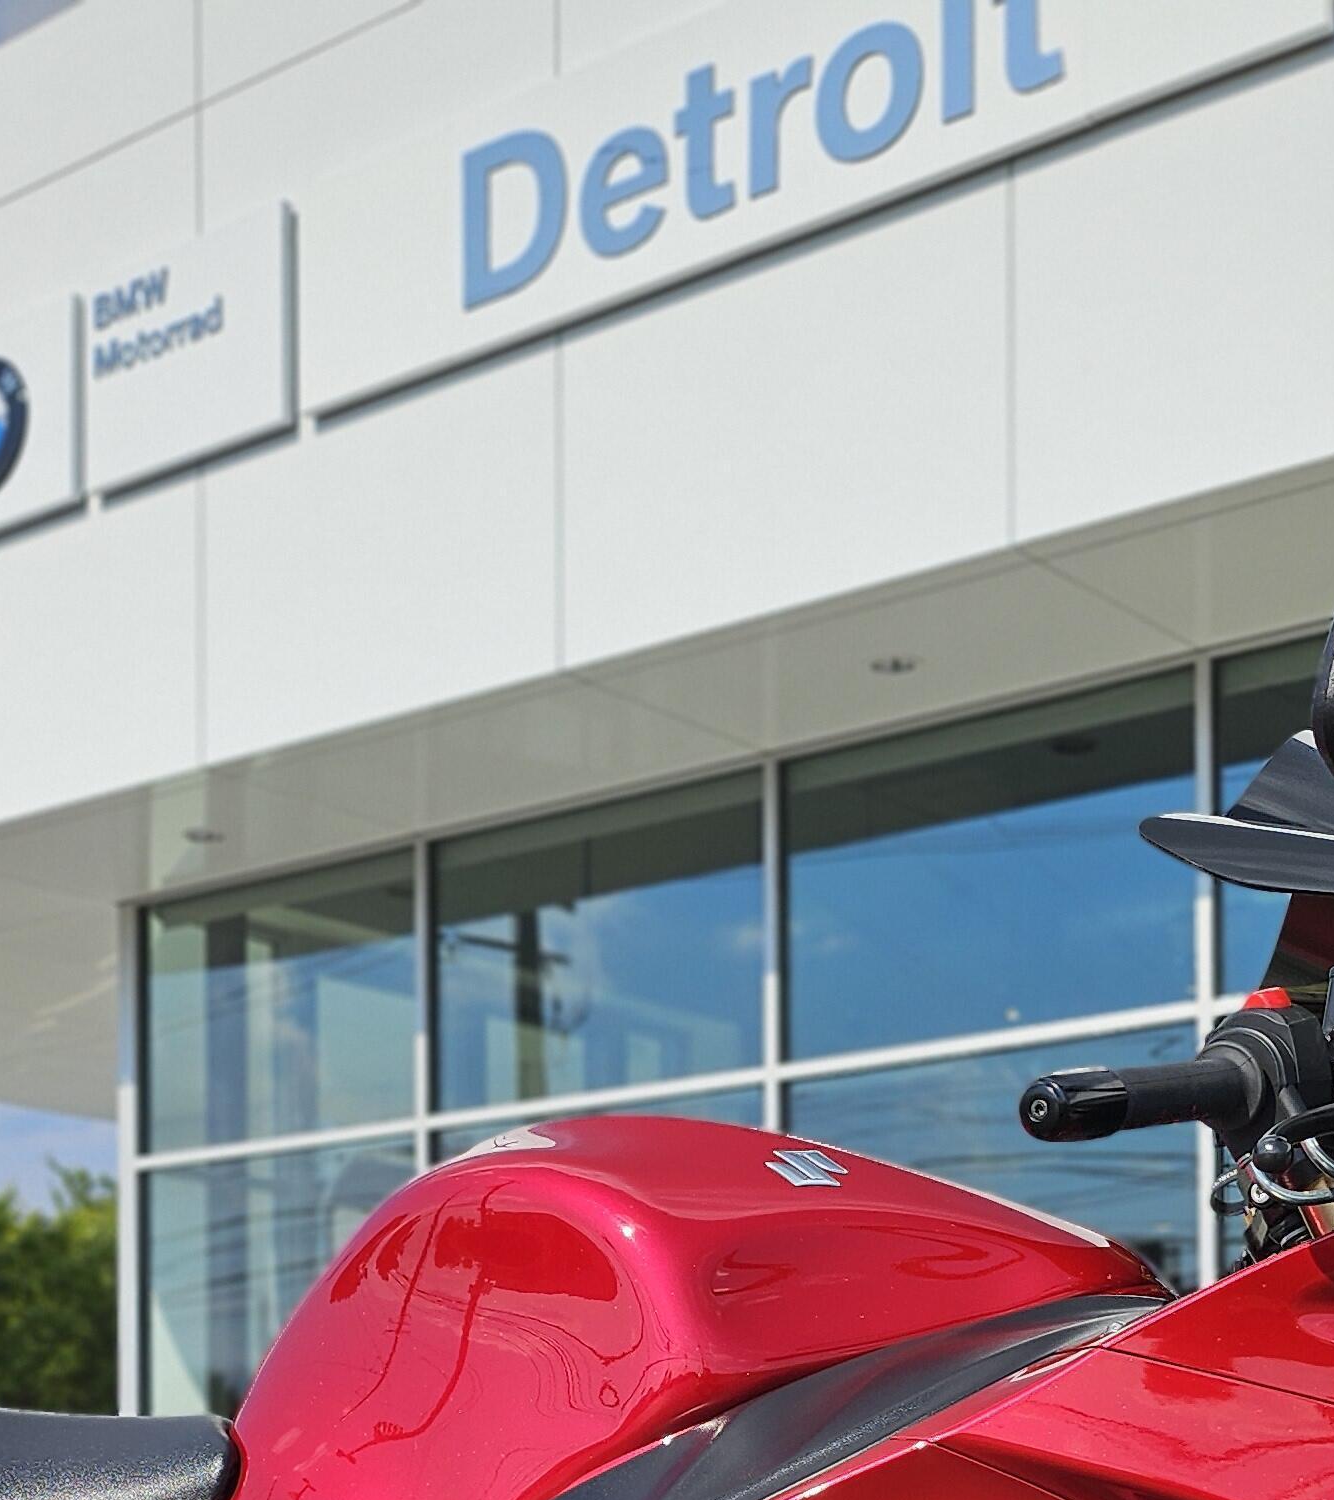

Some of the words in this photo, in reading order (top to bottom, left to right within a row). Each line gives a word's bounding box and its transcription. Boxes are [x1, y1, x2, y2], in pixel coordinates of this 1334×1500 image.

[462, 0, 1064, 312] Detroit
[93, 266, 169, 330] BMW
[93, 293, 224, 379] Motorrad
